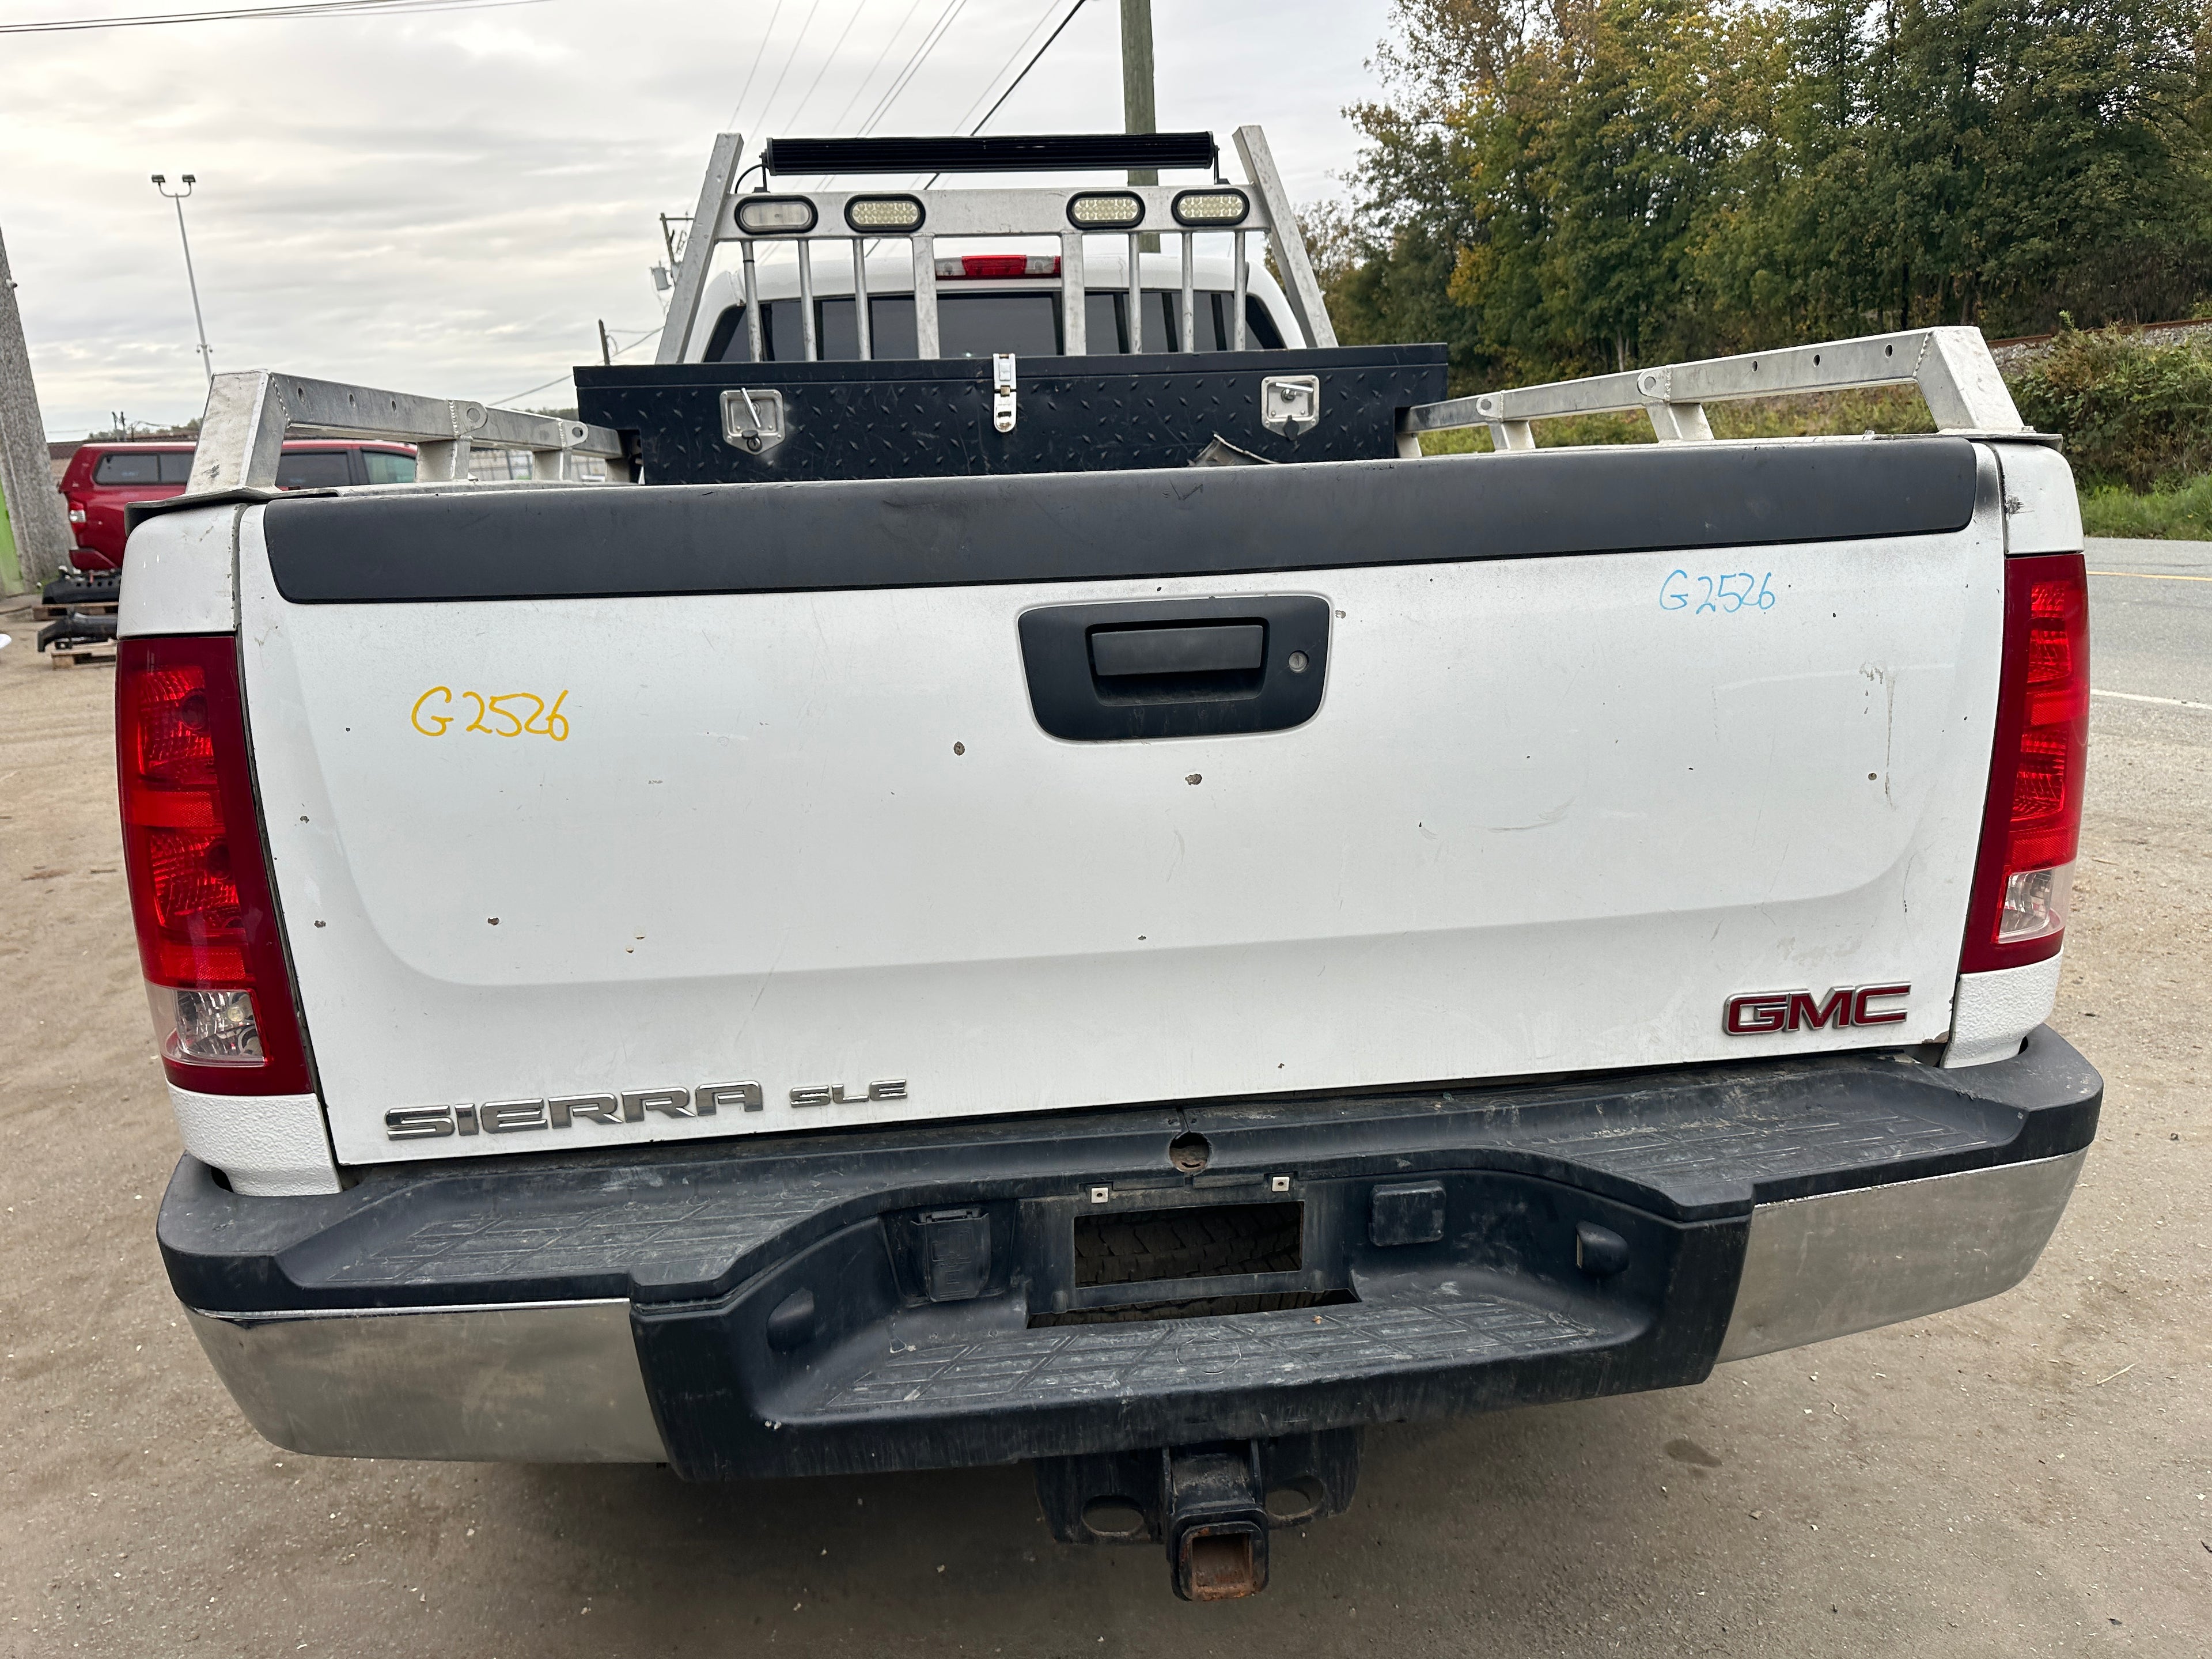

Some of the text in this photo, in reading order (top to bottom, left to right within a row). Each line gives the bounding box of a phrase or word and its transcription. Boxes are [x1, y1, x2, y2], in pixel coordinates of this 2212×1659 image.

[1722, 981, 1912, 1036] GMC
[384, 1079, 908, 1141] SIERRA SLE
